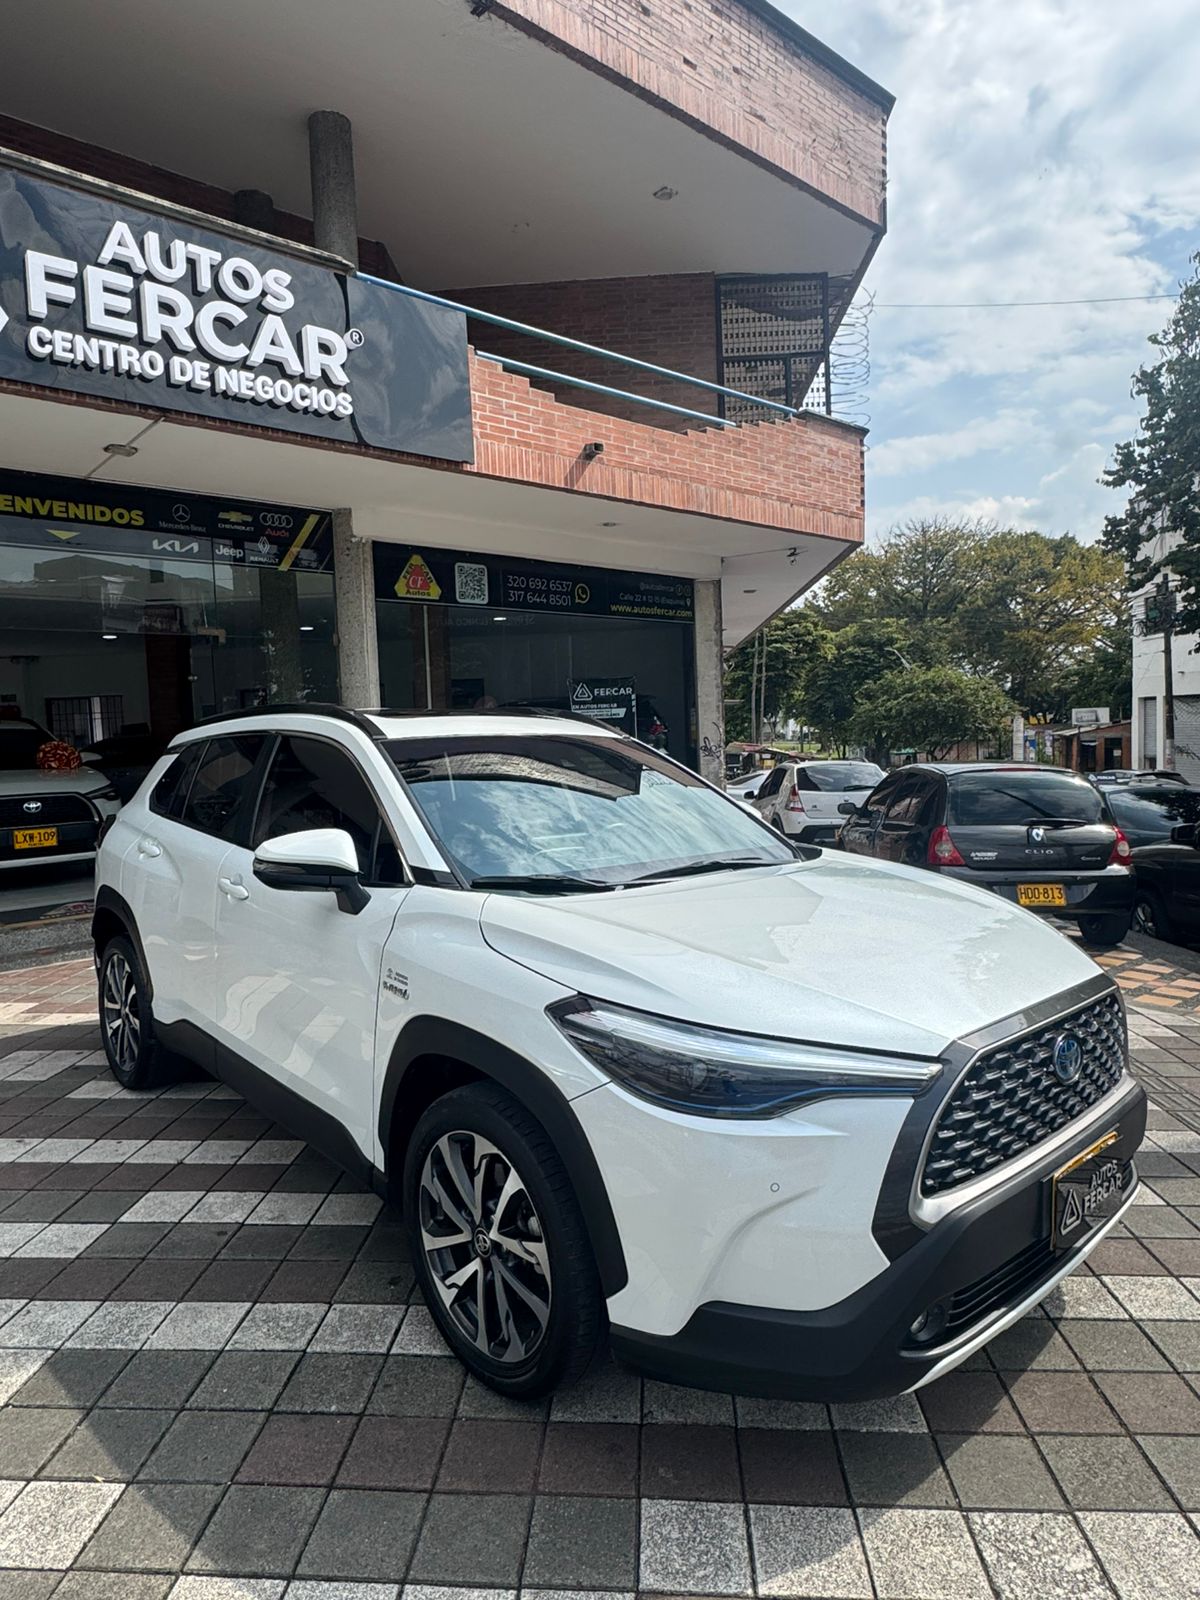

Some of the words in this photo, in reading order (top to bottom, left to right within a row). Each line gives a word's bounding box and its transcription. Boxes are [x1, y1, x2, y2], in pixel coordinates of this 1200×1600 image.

[98, 220, 294, 313] AUTOS
[25, 249, 350, 386] FERCAR
[28, 325, 164, 381] CENTRO
[169, 355, 210, 391] DE
[214, 366, 354, 418] NEGOCIOS
[158, 520, 207, 533] Mercedes-Benz
[218, 523, 255, 532] CHEVROLET
[152, 538, 199, 553] KIA
[215, 545, 244, 559] Jeep
[250, 556, 279, 564] RENAULT
[507, 575, 527, 588] 320
[528, 577, 548, 590] 692
[549, 580, 572, 592] 6537
[508, 590, 525, 602] 317
[526, 592, 547, 604] 644
[549, 594, 571, 606] 8501
[610, 604, 692, 617] www.autosfercar.com
[594, 686, 632, 696] FERCAR
[1091, 1160, 1118, 1189] AUTOS
[1084, 1173, 1122, 1214] FERCAR
